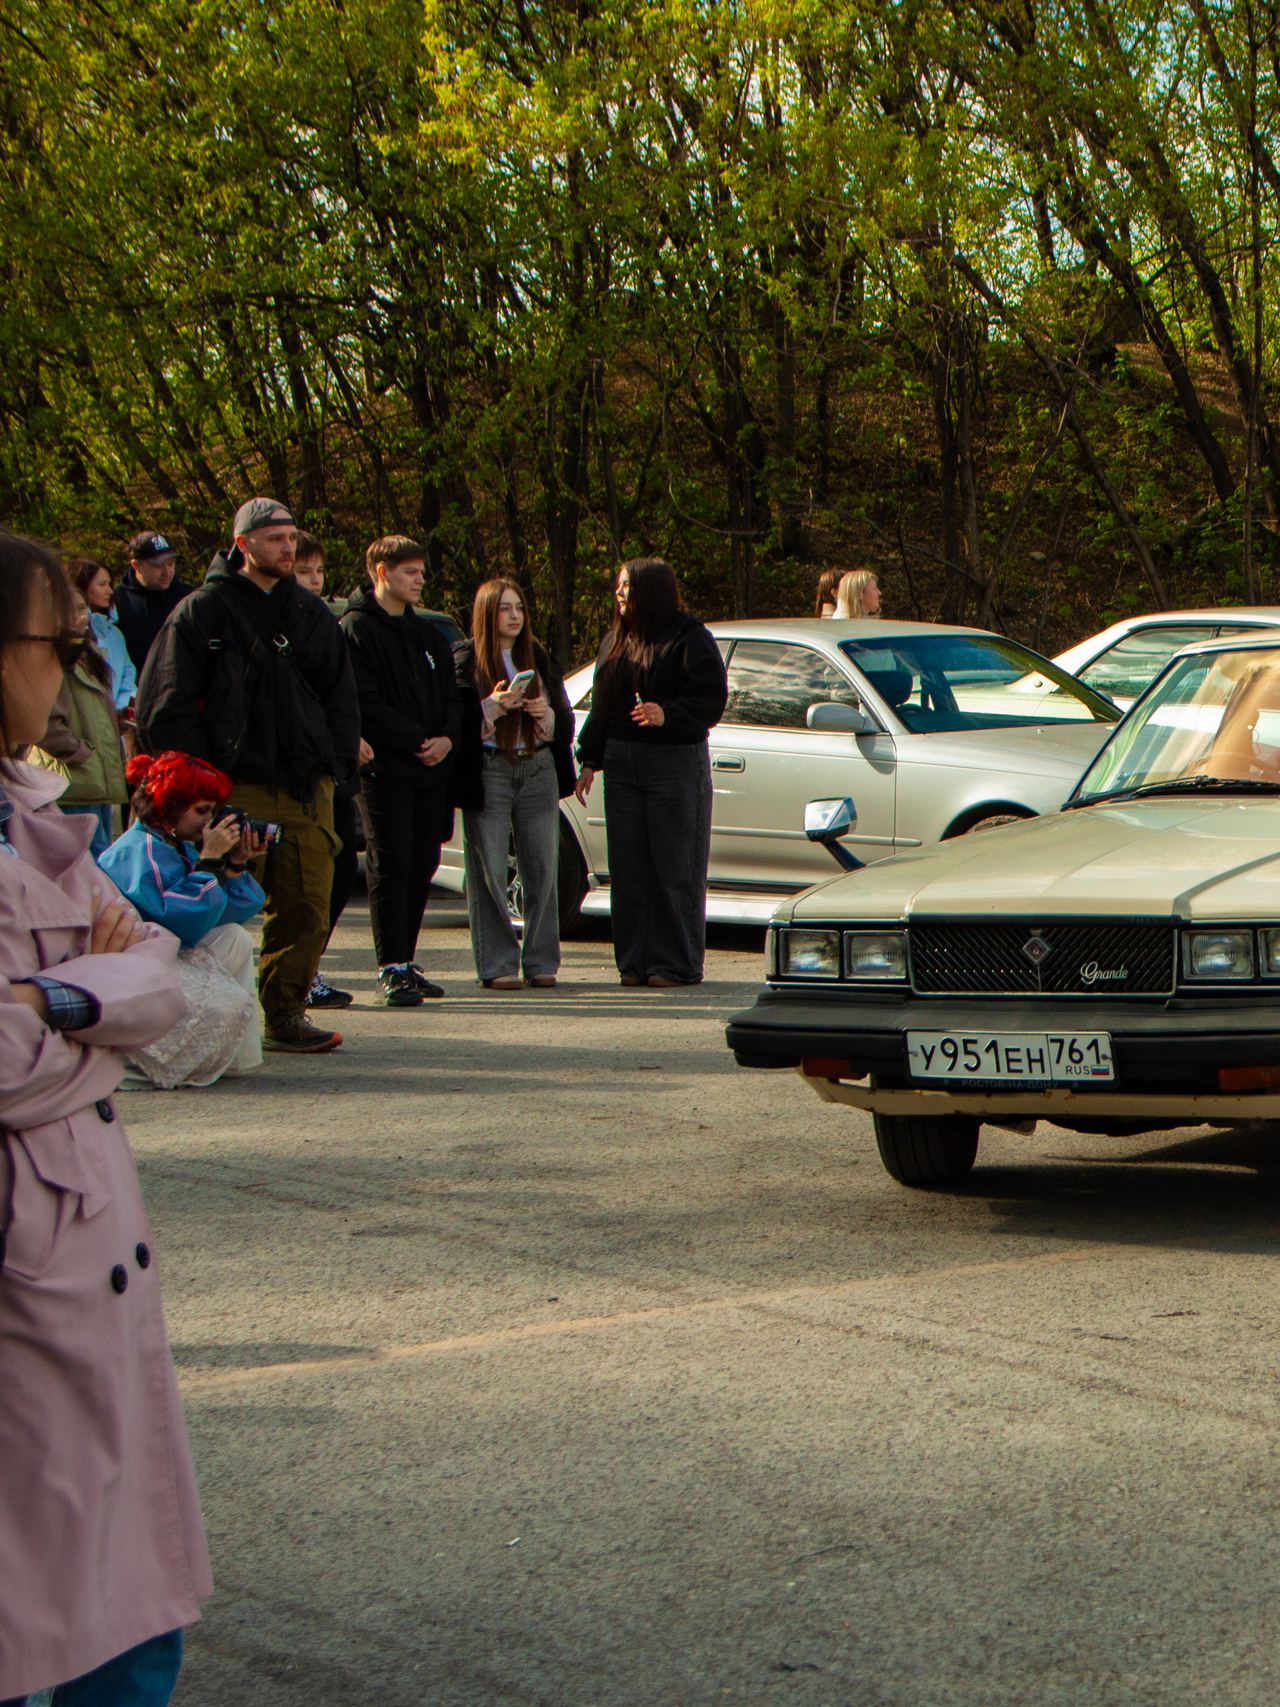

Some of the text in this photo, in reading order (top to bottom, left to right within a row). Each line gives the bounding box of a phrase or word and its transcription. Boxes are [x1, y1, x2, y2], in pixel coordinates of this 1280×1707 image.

[1080, 961, 1129, 985] Grande
[1050, 1037, 1101, 1065] 761
[1065, 1065, 1091, 1076] RUS
